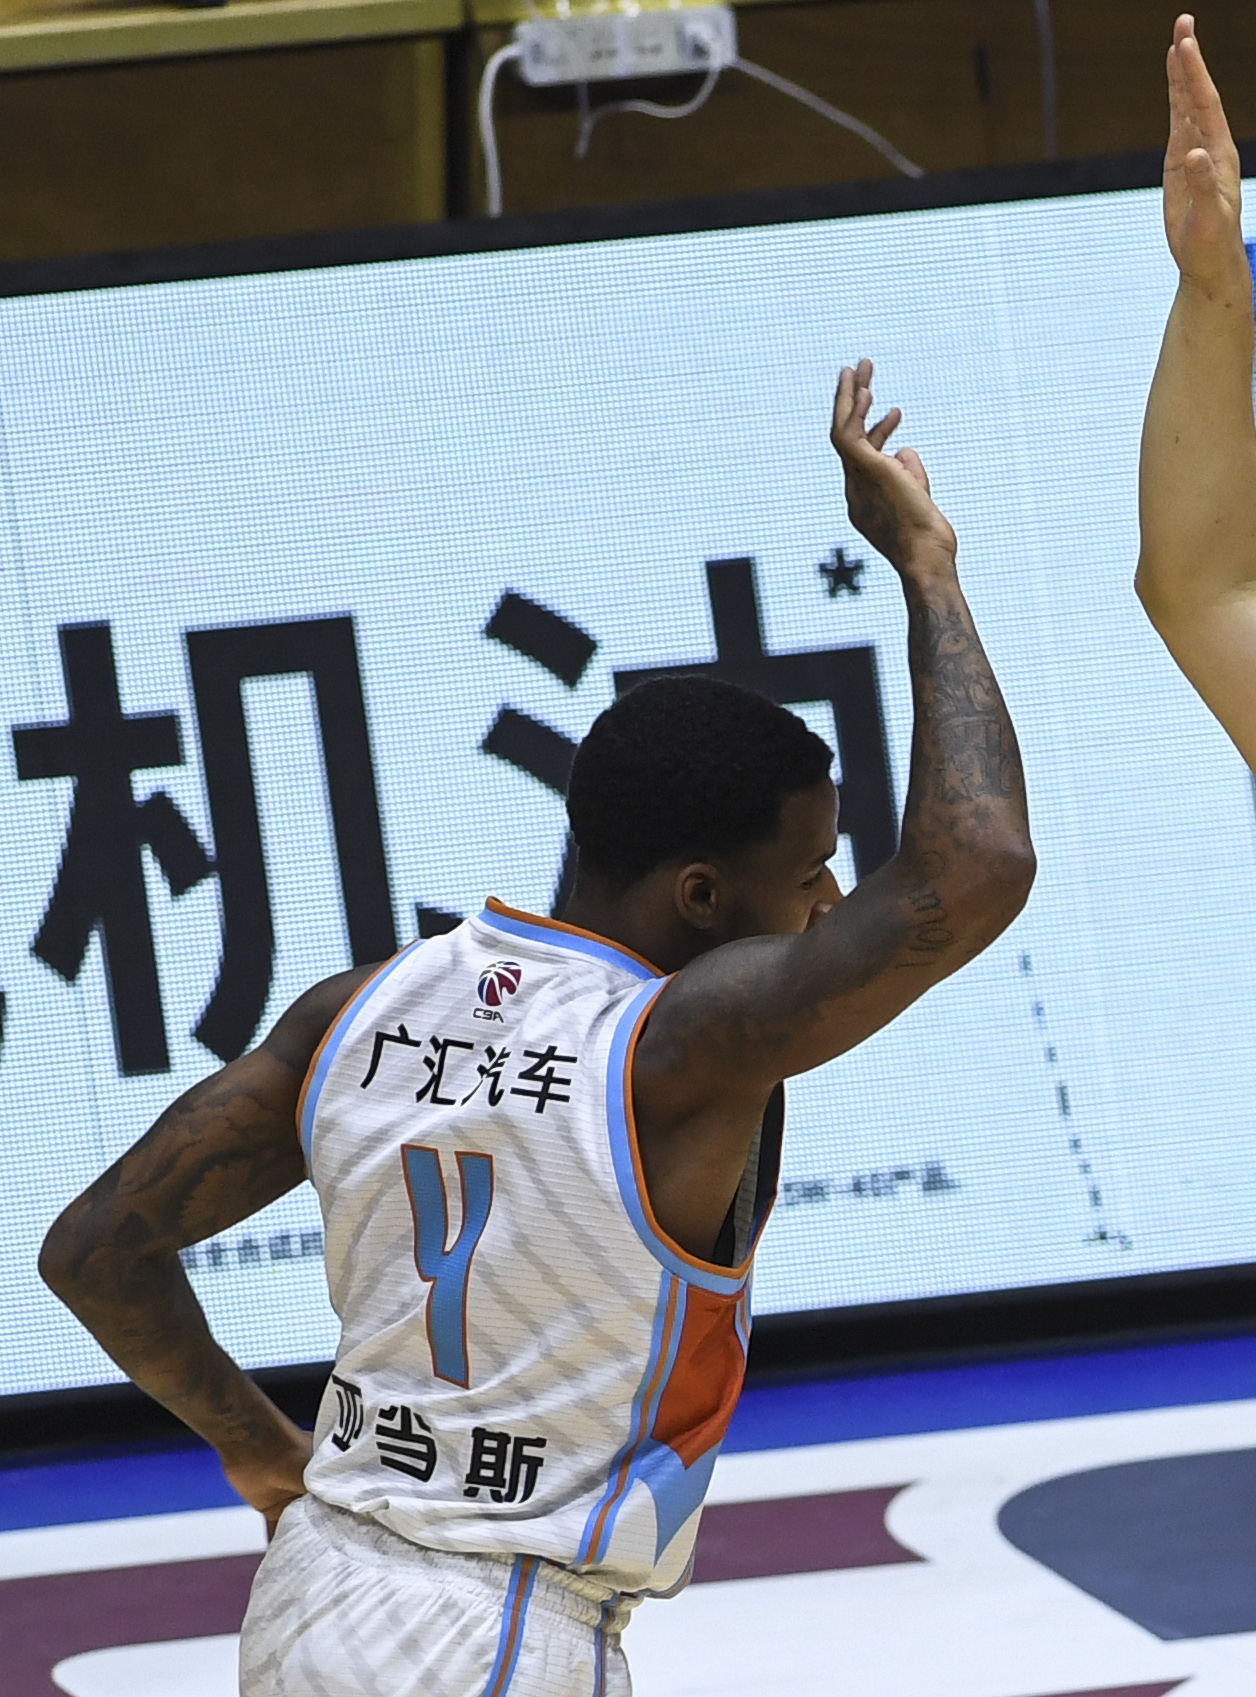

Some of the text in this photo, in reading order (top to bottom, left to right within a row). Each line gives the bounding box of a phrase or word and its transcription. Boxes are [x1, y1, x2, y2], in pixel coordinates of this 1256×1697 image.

[360, 1023, 578, 1114] 广汇汽车
[401, 1144, 494, 1390] 4
[331, 1374, 548, 1504] 亚当斯
